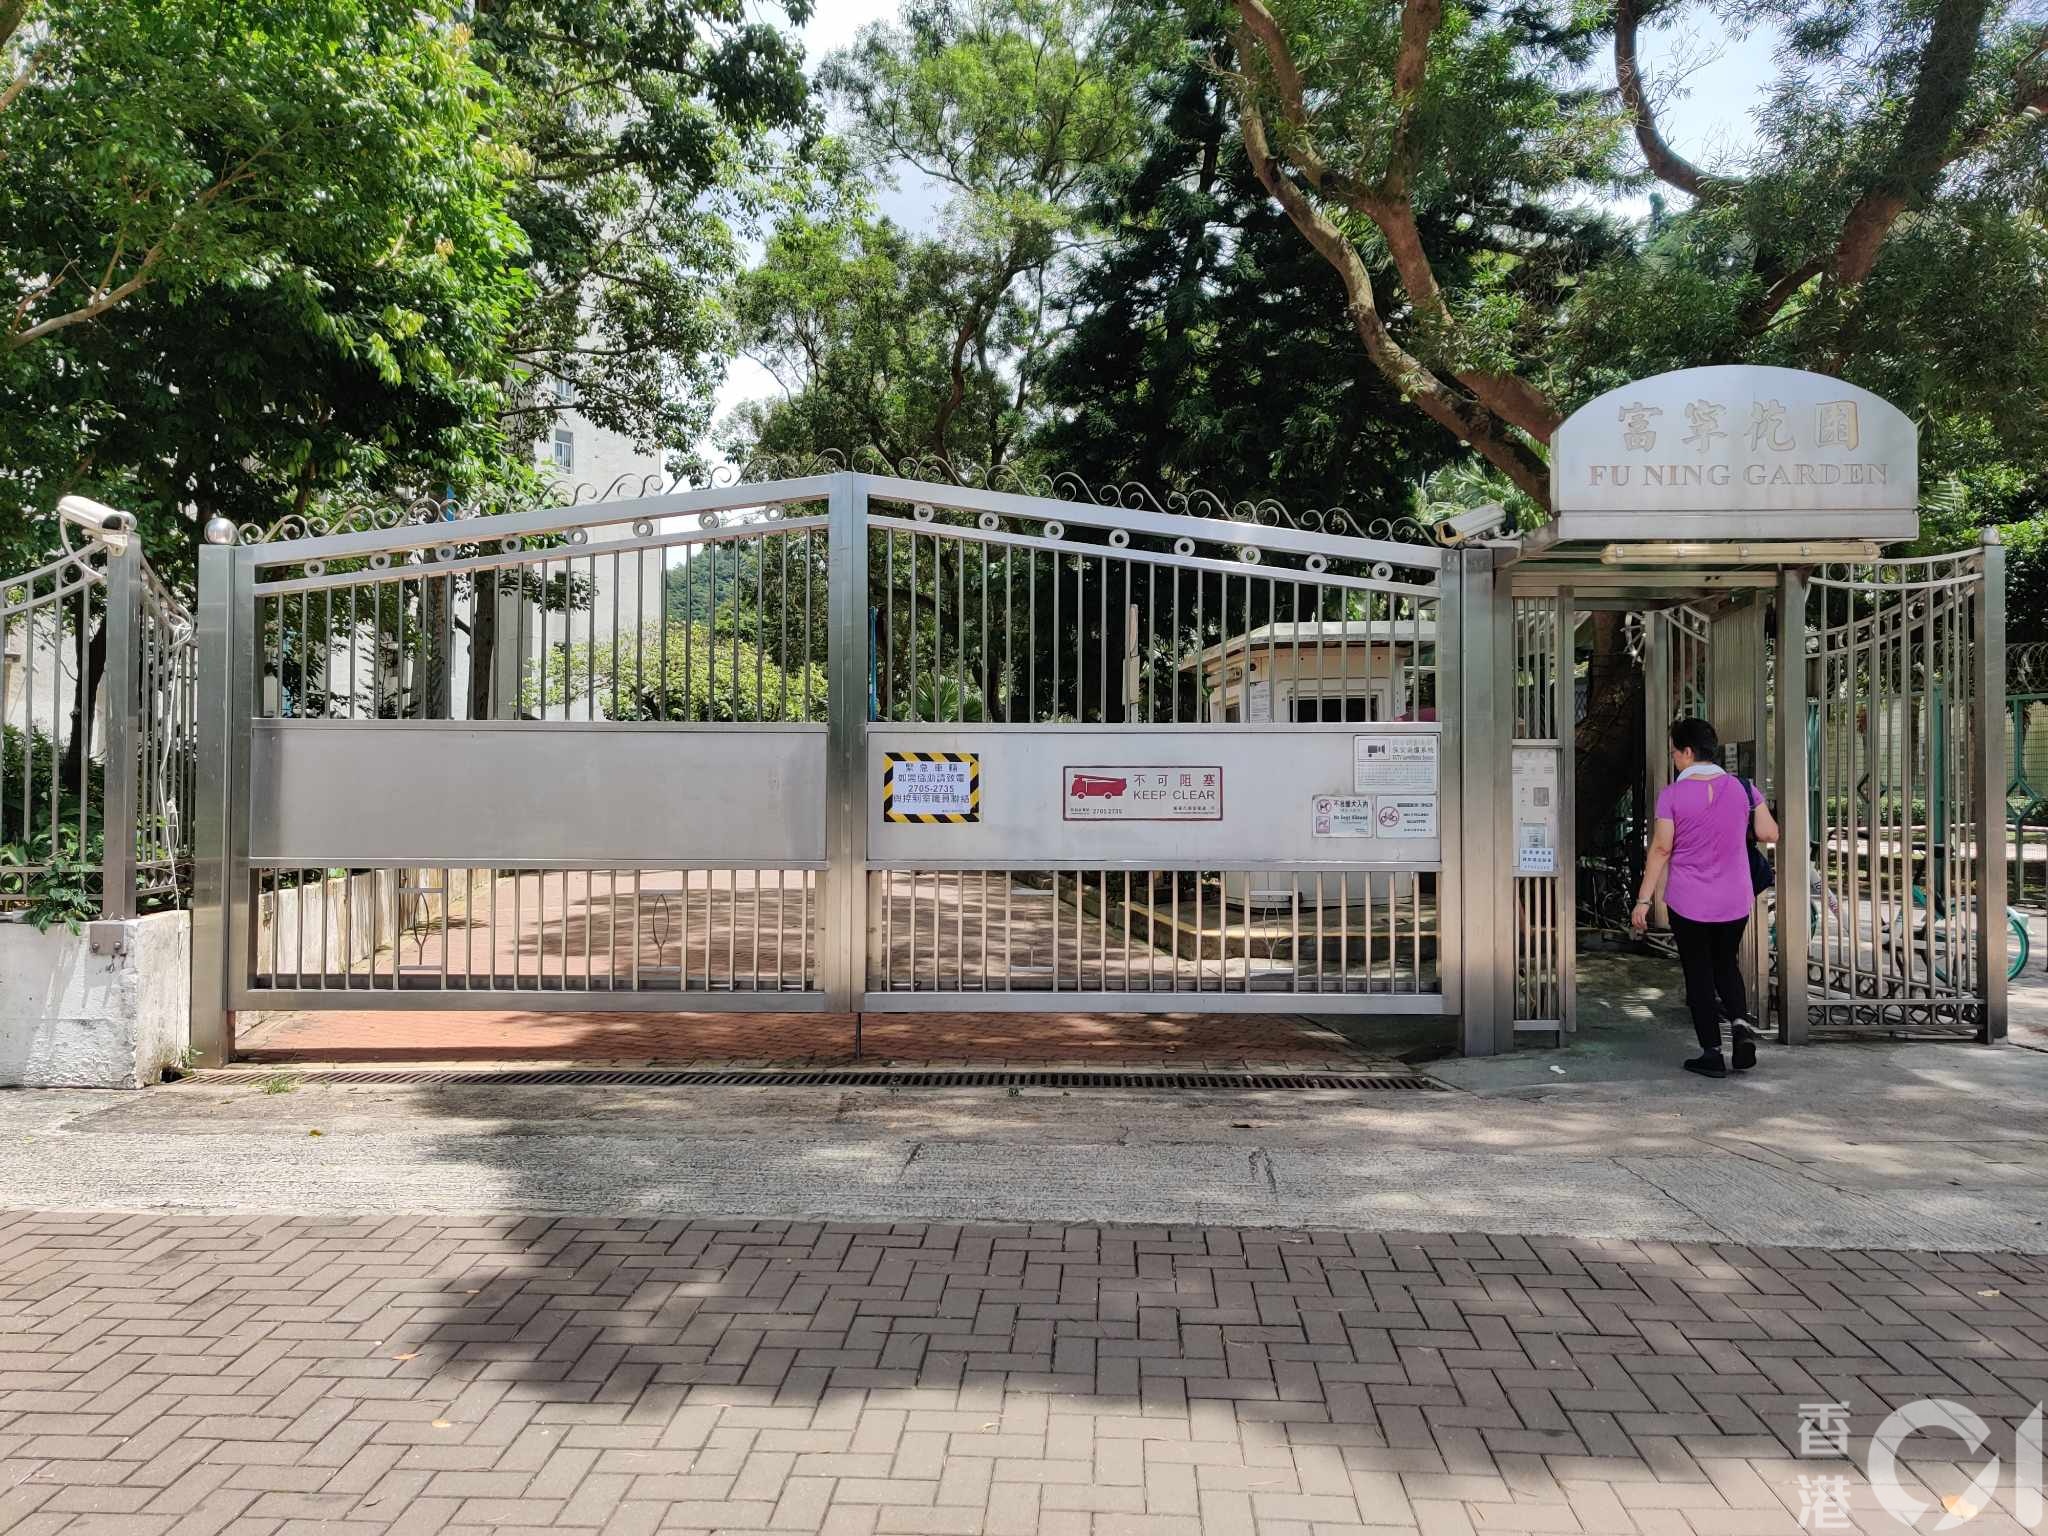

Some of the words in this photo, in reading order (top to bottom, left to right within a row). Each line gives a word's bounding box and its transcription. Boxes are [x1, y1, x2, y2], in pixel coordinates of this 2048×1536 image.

[1617, 399, 1860, 452] 富寧花園
[1589, 465, 1632, 487] FU
[1641, 464, 1731, 487] NING
[1743, 463, 1889, 486] GARDEN
[1133, 774, 1216, 787] 不可阻塞
[908, 785, 955, 793] 2705-2735
[1134, 790, 1167, 801] KEEP
[1172, 790, 1216, 801] CLEAR
